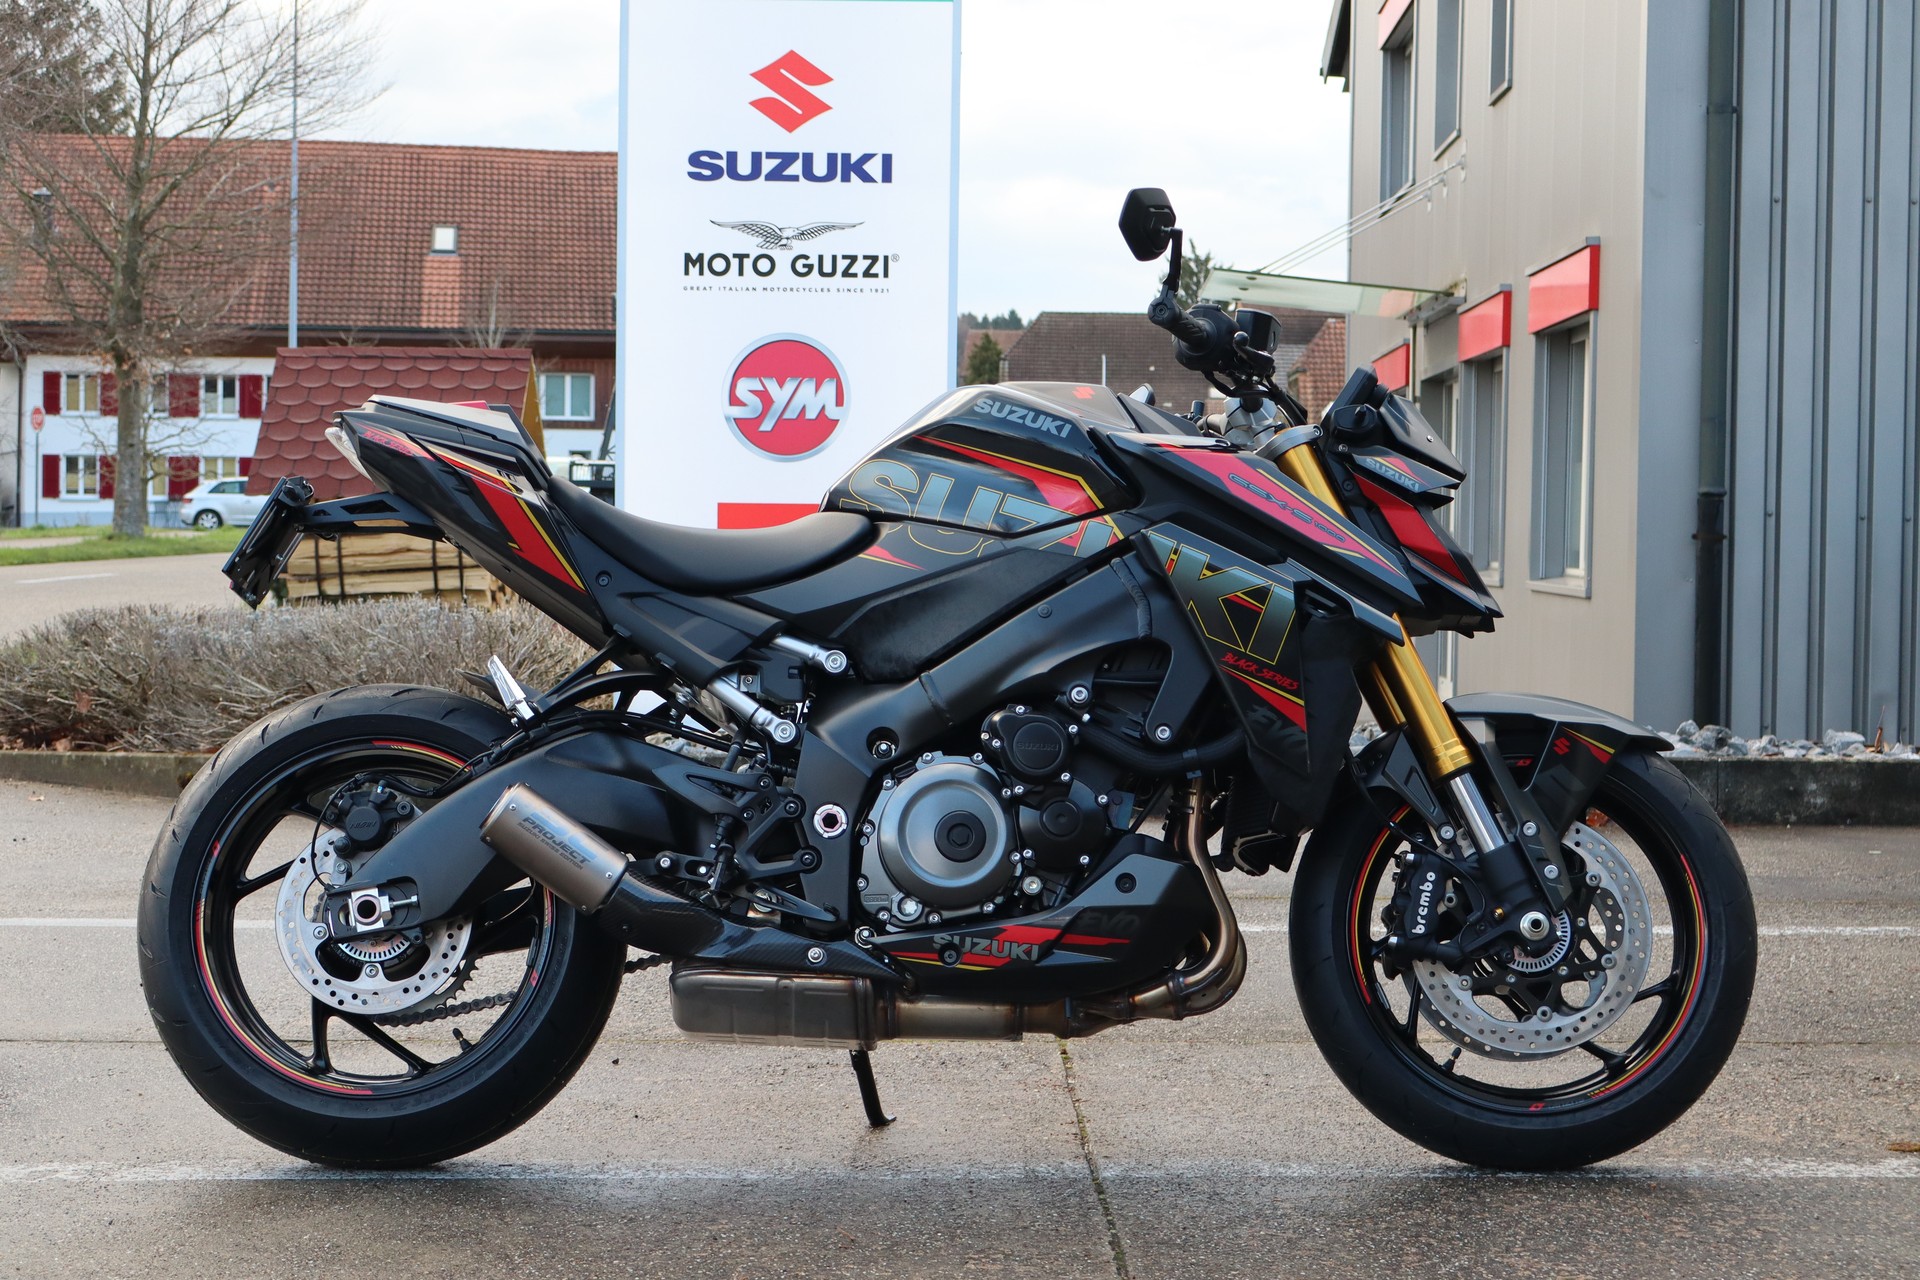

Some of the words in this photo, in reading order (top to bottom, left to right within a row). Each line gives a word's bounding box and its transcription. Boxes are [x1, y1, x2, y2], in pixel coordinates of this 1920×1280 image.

[687, 150, 893, 184] SUZUKI
[683, 252, 776, 277] MOTO
[728, 377, 844, 432] SYM
[974, 399, 1072, 438] SUZUKI
[1365, 458, 1420, 491] SUZUKI
[1219, 652, 1260, 675] BLACK
[1257, 668, 1299, 690] SERIES
[1016, 741, 1060, 751] SUZUKI
[516, 821, 541, 840] SUZUKI
[521, 816, 592, 865] PROJECT
[1411, 871, 1436, 934] brembo
[932, 934, 1040, 961] SUZUKI
